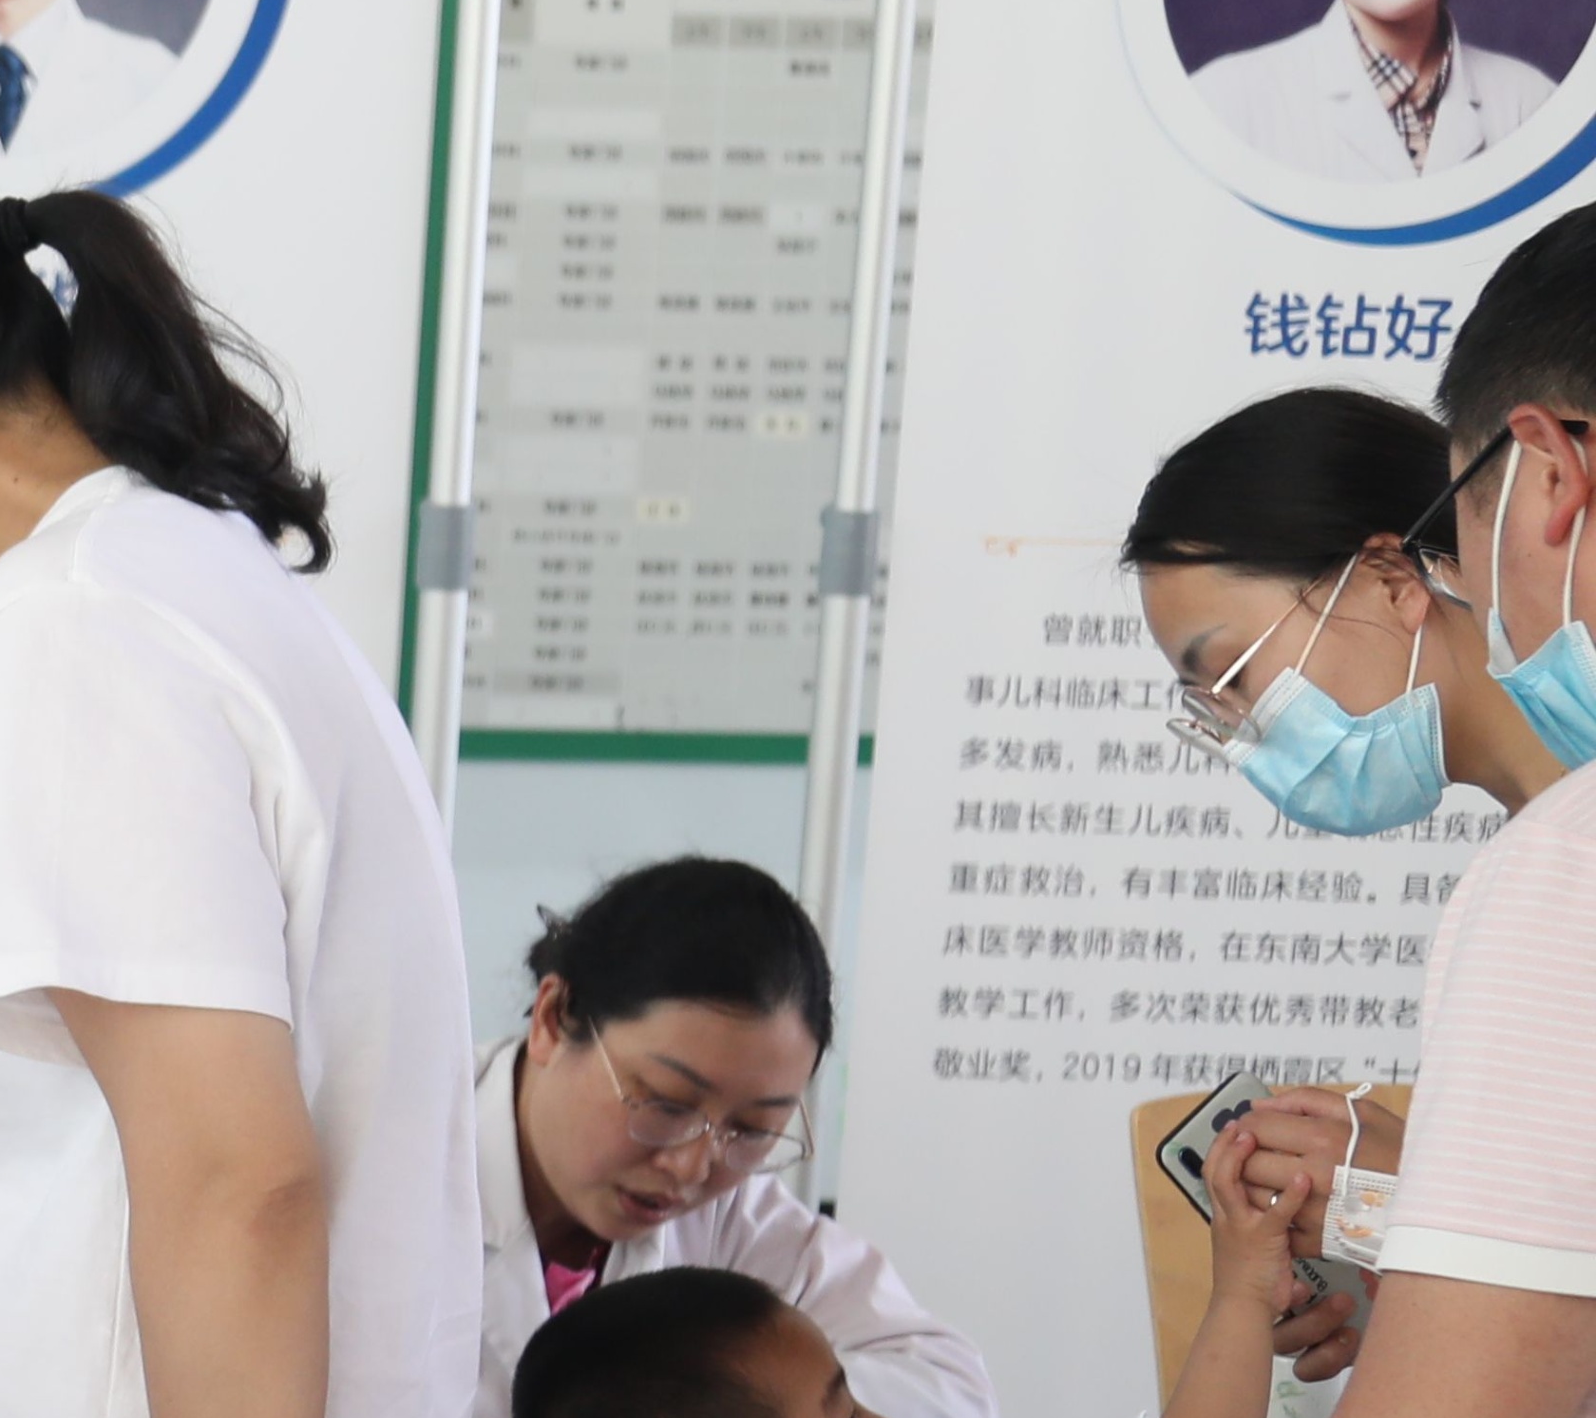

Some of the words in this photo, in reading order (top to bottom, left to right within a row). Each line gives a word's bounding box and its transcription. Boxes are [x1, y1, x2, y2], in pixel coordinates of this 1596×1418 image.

[1244, 291, 1455, 361] 钱钻好
[1042, 612, 1162, 648] 曾就职
[942, 924, 1436, 967] 床医学教师资格，在东南大学医
